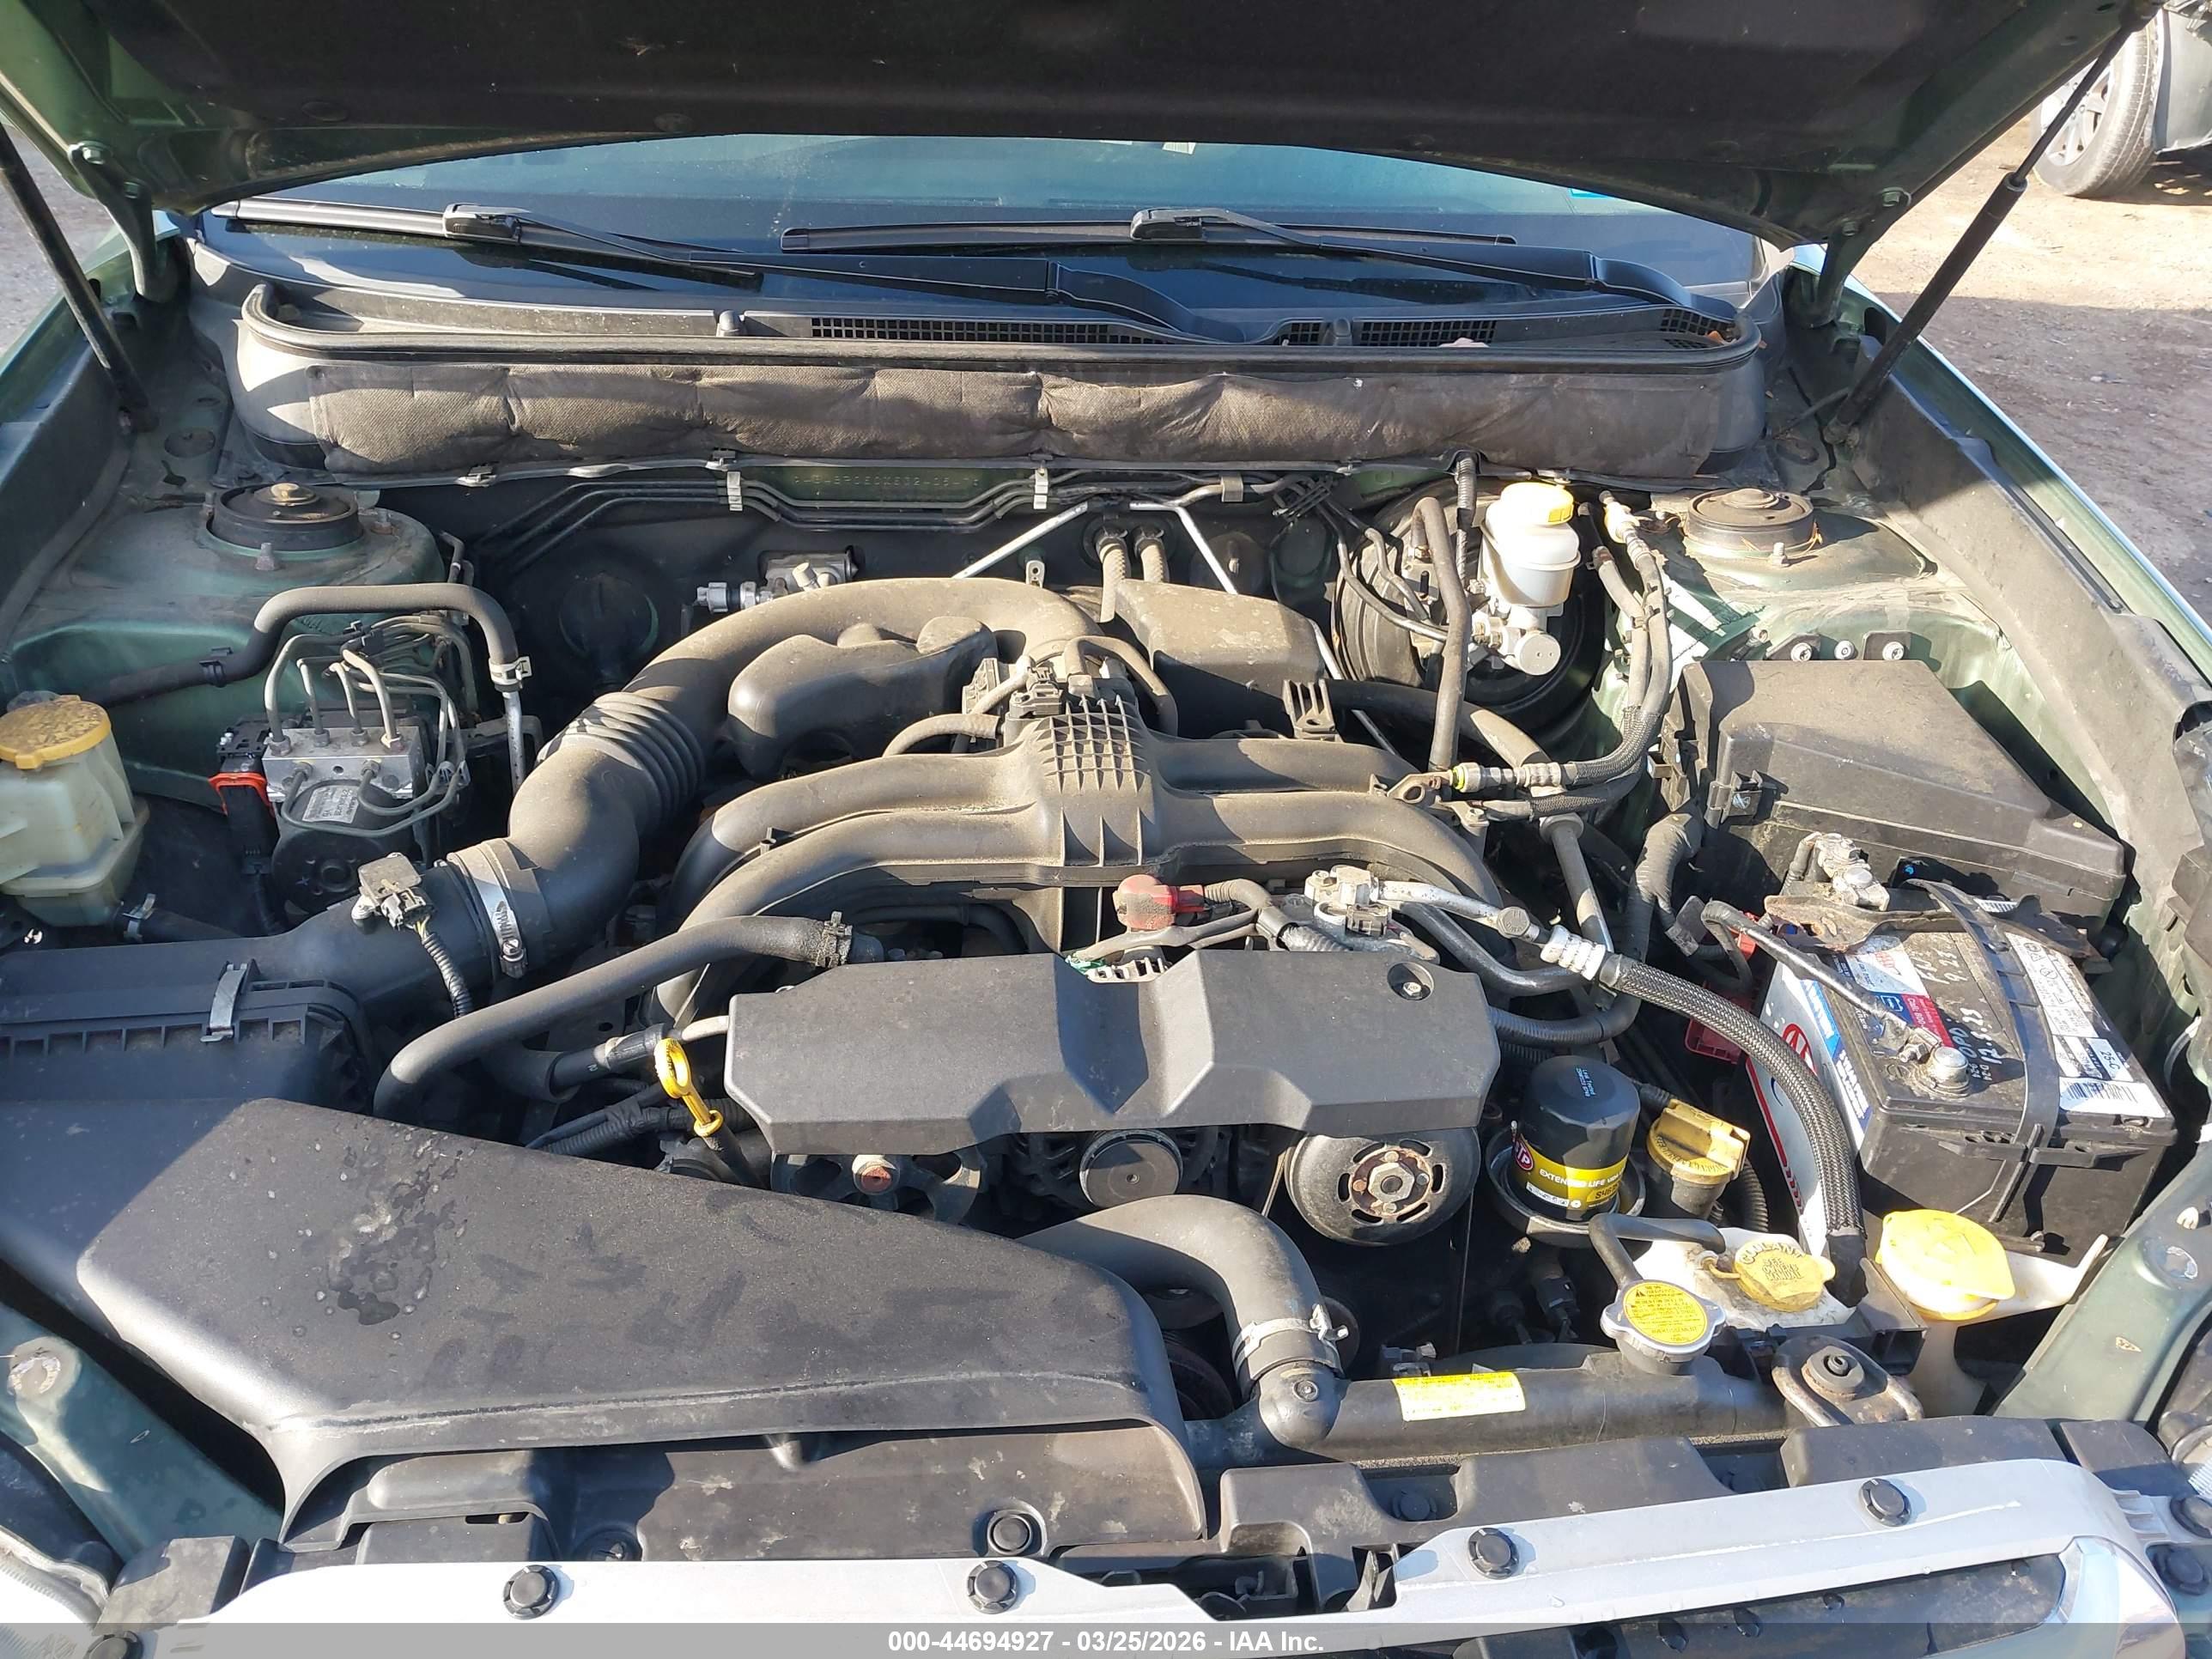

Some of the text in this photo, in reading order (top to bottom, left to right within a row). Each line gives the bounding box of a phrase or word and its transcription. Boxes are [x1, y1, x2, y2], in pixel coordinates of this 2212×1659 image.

[2100, 1050, 2121, 1071] 25-C
[1589, 1178, 1606, 1188] LIFE
[1740, 1242, 1804, 1265] COOLANT
